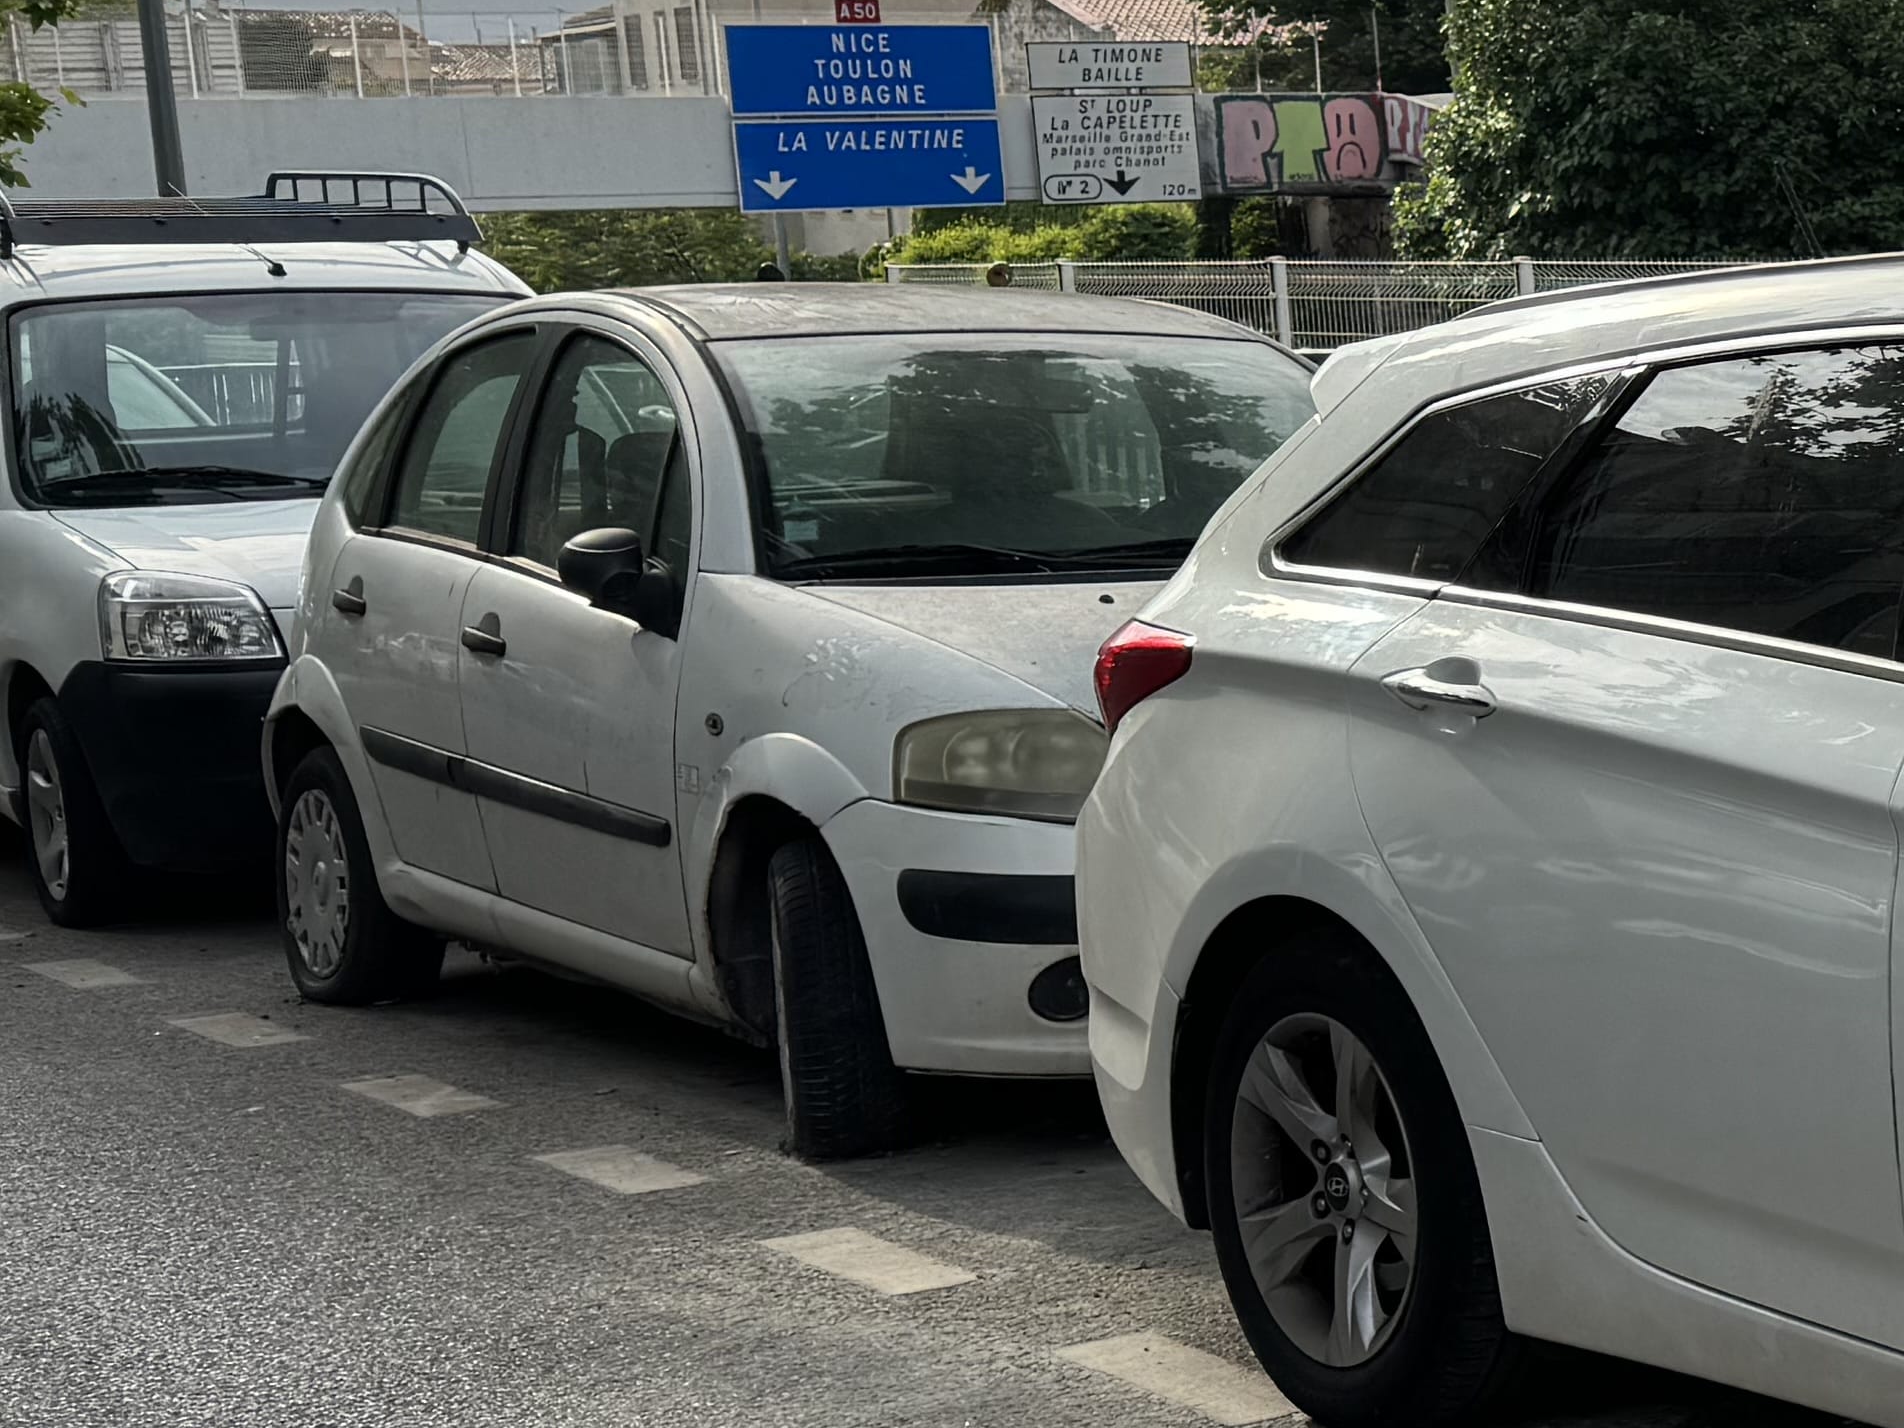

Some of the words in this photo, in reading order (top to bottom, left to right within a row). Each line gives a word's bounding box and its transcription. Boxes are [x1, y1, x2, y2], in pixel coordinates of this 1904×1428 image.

[831, 33, 890, 53] NICE
[1058, 48, 1079, 63] LA
[1092, 48, 1163, 63] TIMONE
[814, 59, 912, 79] TOULON
[1082, 67, 1144, 82] BAILLE
[807, 85, 926, 105] AUBAGNE
[1106, 99, 1152, 114] LOUP
[1051, 117, 1070, 131] La
[1081, 114, 1182, 129] CAPELETTE
[778, 132, 807, 152] LA
[826, 129, 964, 151] VALENTINE
[1042, 132, 1111, 144] Marseille
[1051, 145, 1095, 158] palais
[1104, 143, 1183, 158] omnisports
[1074, 157, 1106, 171] parc
[1115, 156, 1166, 168] Chanot
[1080, 181, 1090, 194] 2
